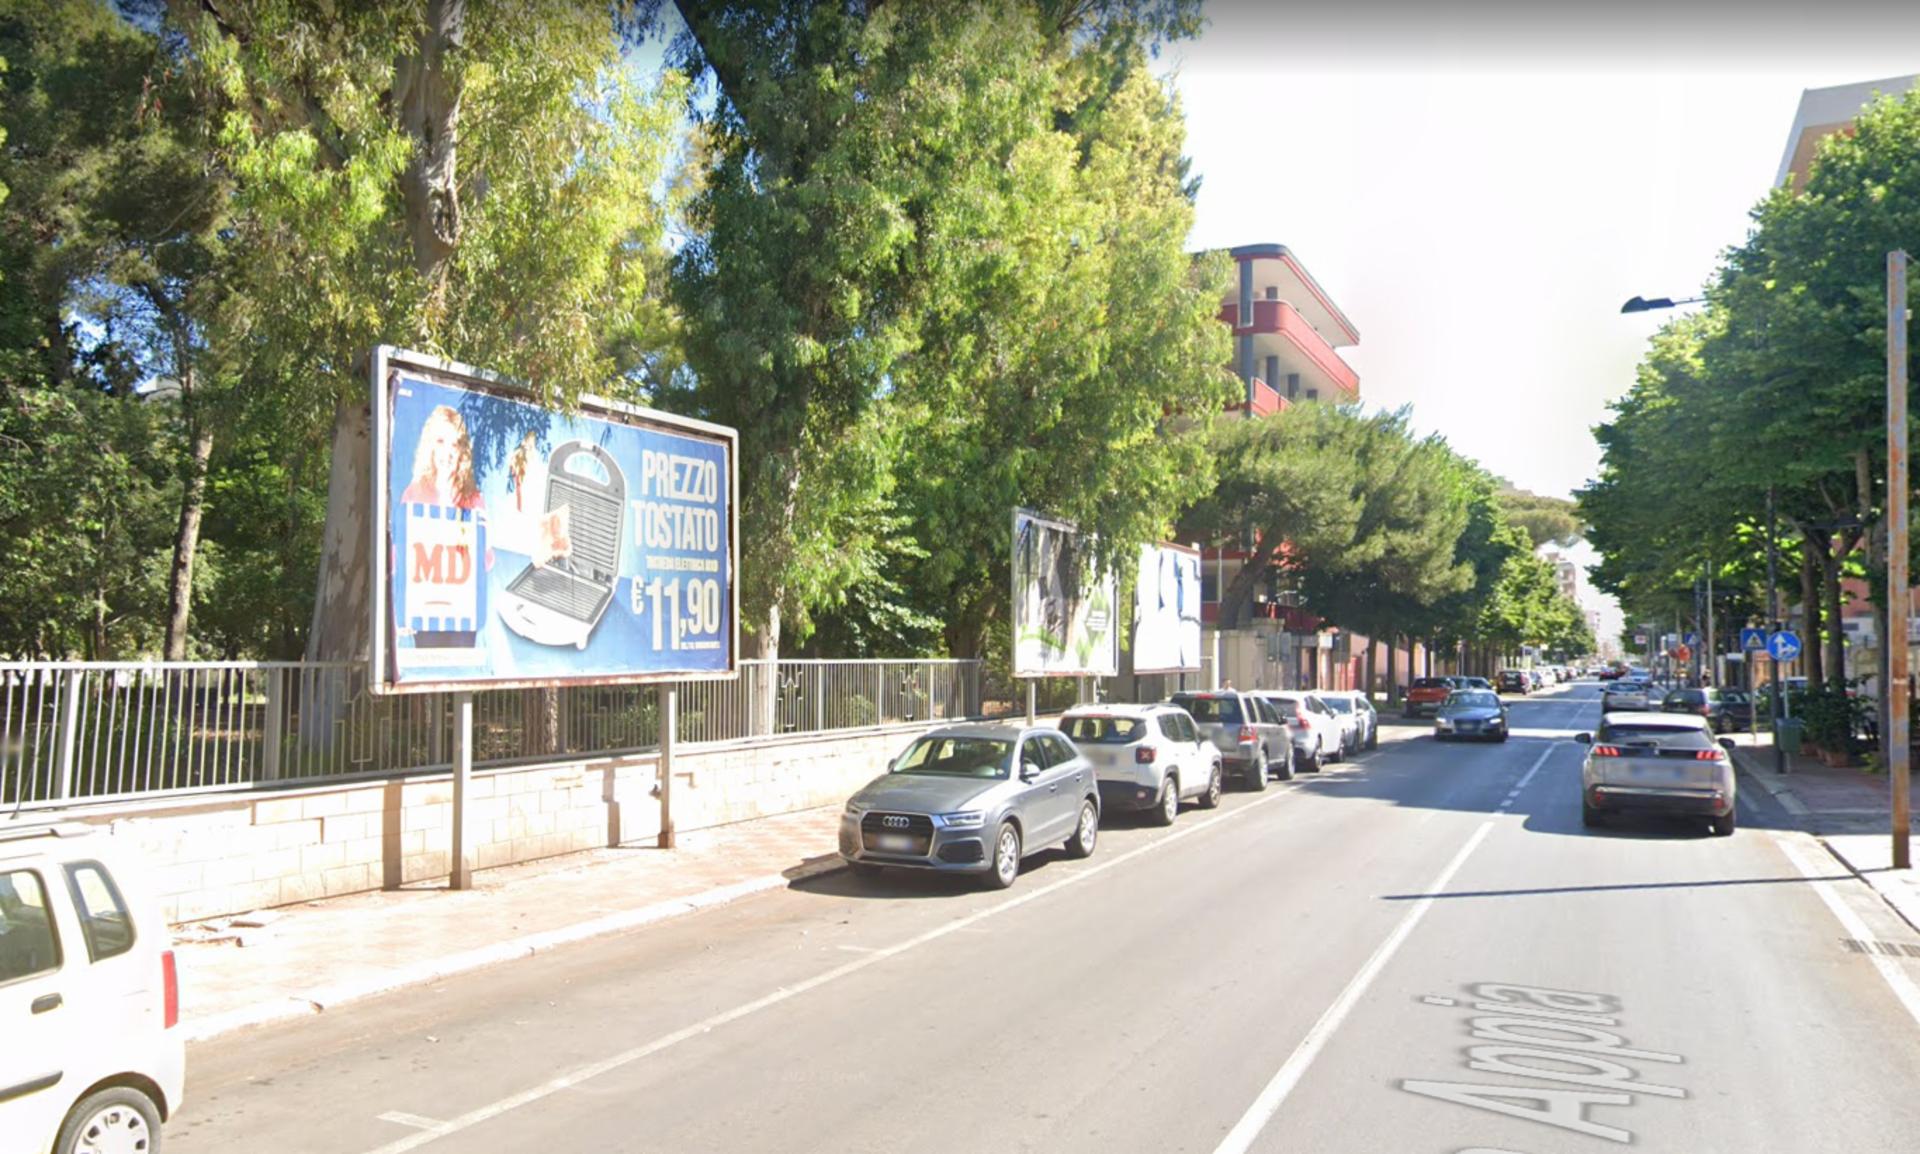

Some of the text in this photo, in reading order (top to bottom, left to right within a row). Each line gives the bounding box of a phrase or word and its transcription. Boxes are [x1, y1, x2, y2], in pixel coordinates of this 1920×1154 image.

[642, 448, 718, 504] PREZZO
[631, 499, 719, 552] TOSTATO
[413, 541, 472, 585] MD
